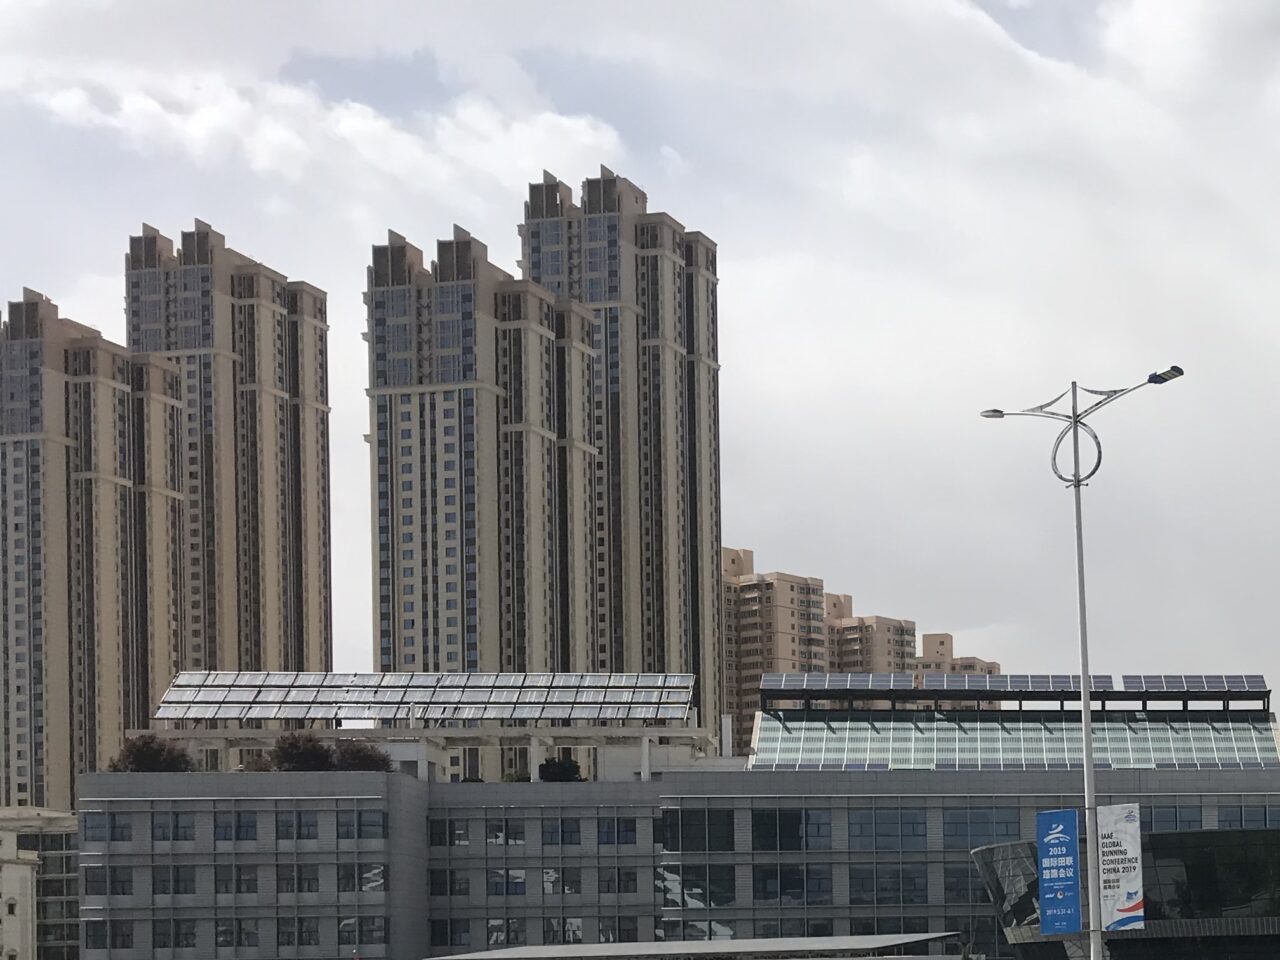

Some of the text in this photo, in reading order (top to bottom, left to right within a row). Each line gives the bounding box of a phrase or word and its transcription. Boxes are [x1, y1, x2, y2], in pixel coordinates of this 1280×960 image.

[1101, 832, 1114, 840] IAAF
[1048, 846, 1067, 855] 2019
[1101, 849, 1128, 857] RUNNING
[1102, 857, 1139, 866] CONFERENCE
[1102, 867, 1120, 875] CHINA
